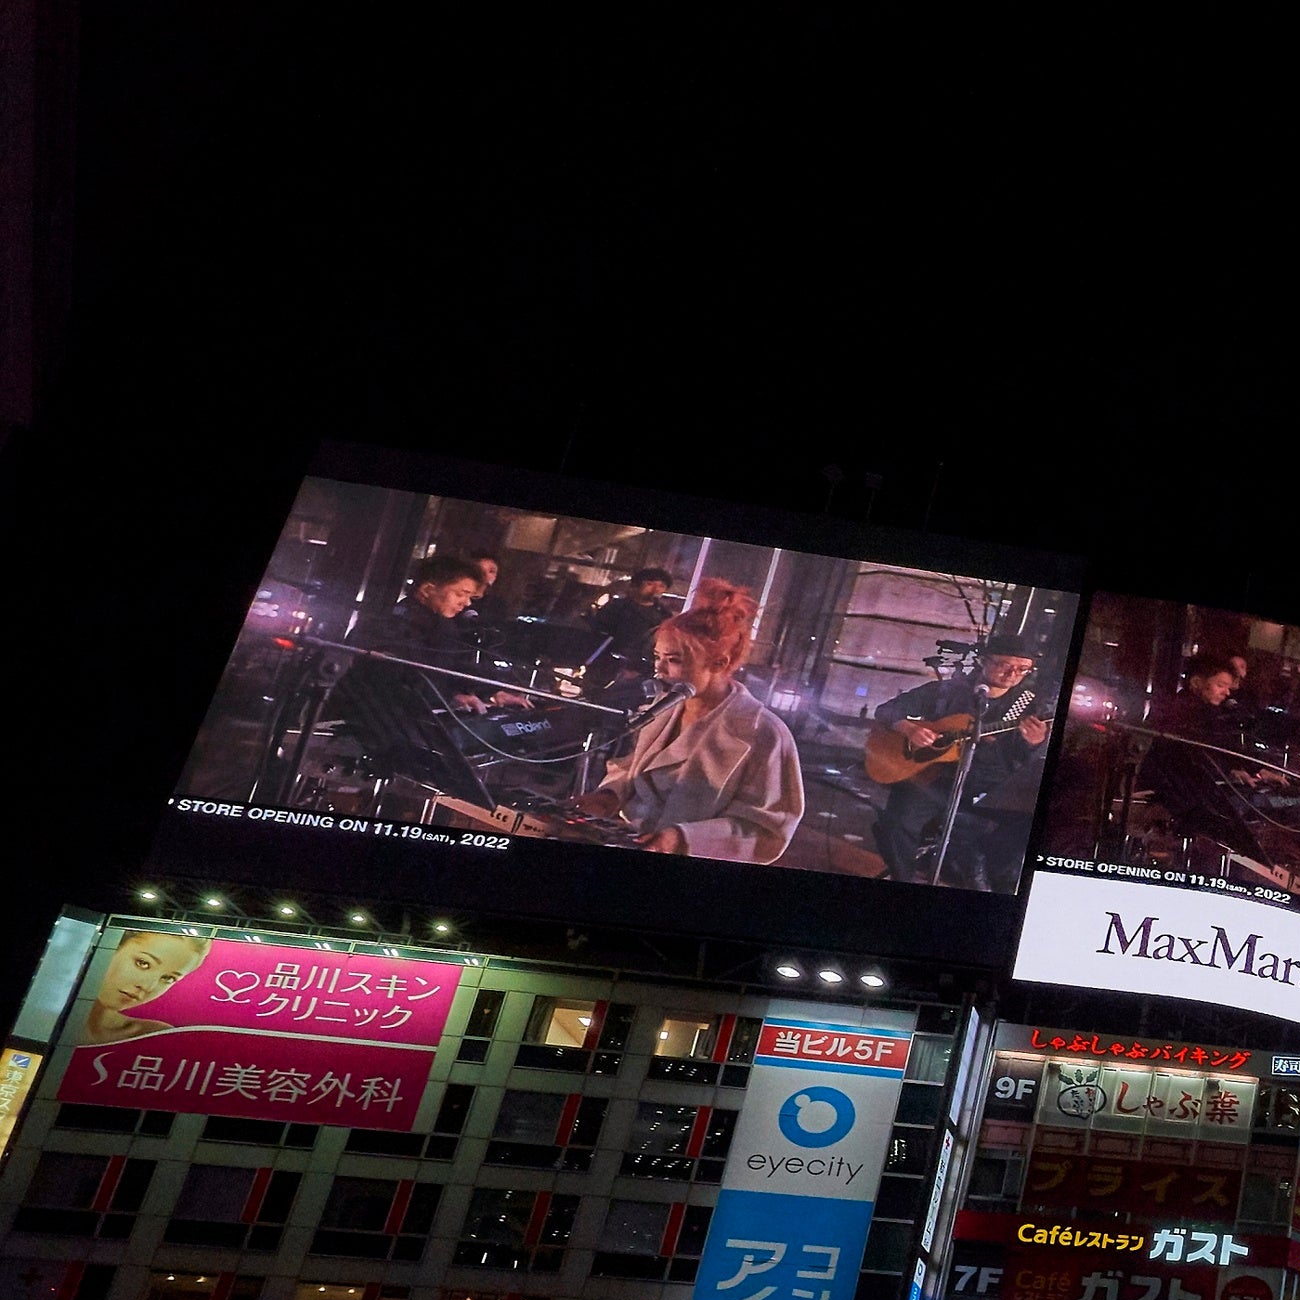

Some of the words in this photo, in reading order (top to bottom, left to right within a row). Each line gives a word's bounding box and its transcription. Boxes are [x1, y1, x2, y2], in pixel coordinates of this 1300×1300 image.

[178, 798, 243, 819] STORE
[247, 806, 334, 830] OPENING
[339, 816, 368, 832] ON
[461, 832, 510, 850] 2022
[1046, 855, 1094, 874] STORE
[1097, 861, 1161, 883] OPENING
[1164, 868, 1187, 884] ON
[1254, 887, 1292, 905] 2022
[264, 961, 441, 1001] 品川スキン
[257, 992, 413, 1030] クリニック
[773, 1031, 895, 1062] 当ビル5F
[1031, 1029, 1251, 1070] しゃぶしゃぶバイキング
[117, 1055, 403, 1113] 品川美容外科
[995, 1076, 1036, 1101] 9F
[1116, 1081, 1241, 1125] しゃぶ葉
[747, 1153, 863, 1184] eyecity
[1149, 1228, 1249, 1267] ガスト
[953, 1265, 1004, 1293] 7F
[1015, 1269, 1071, 1291] Café
